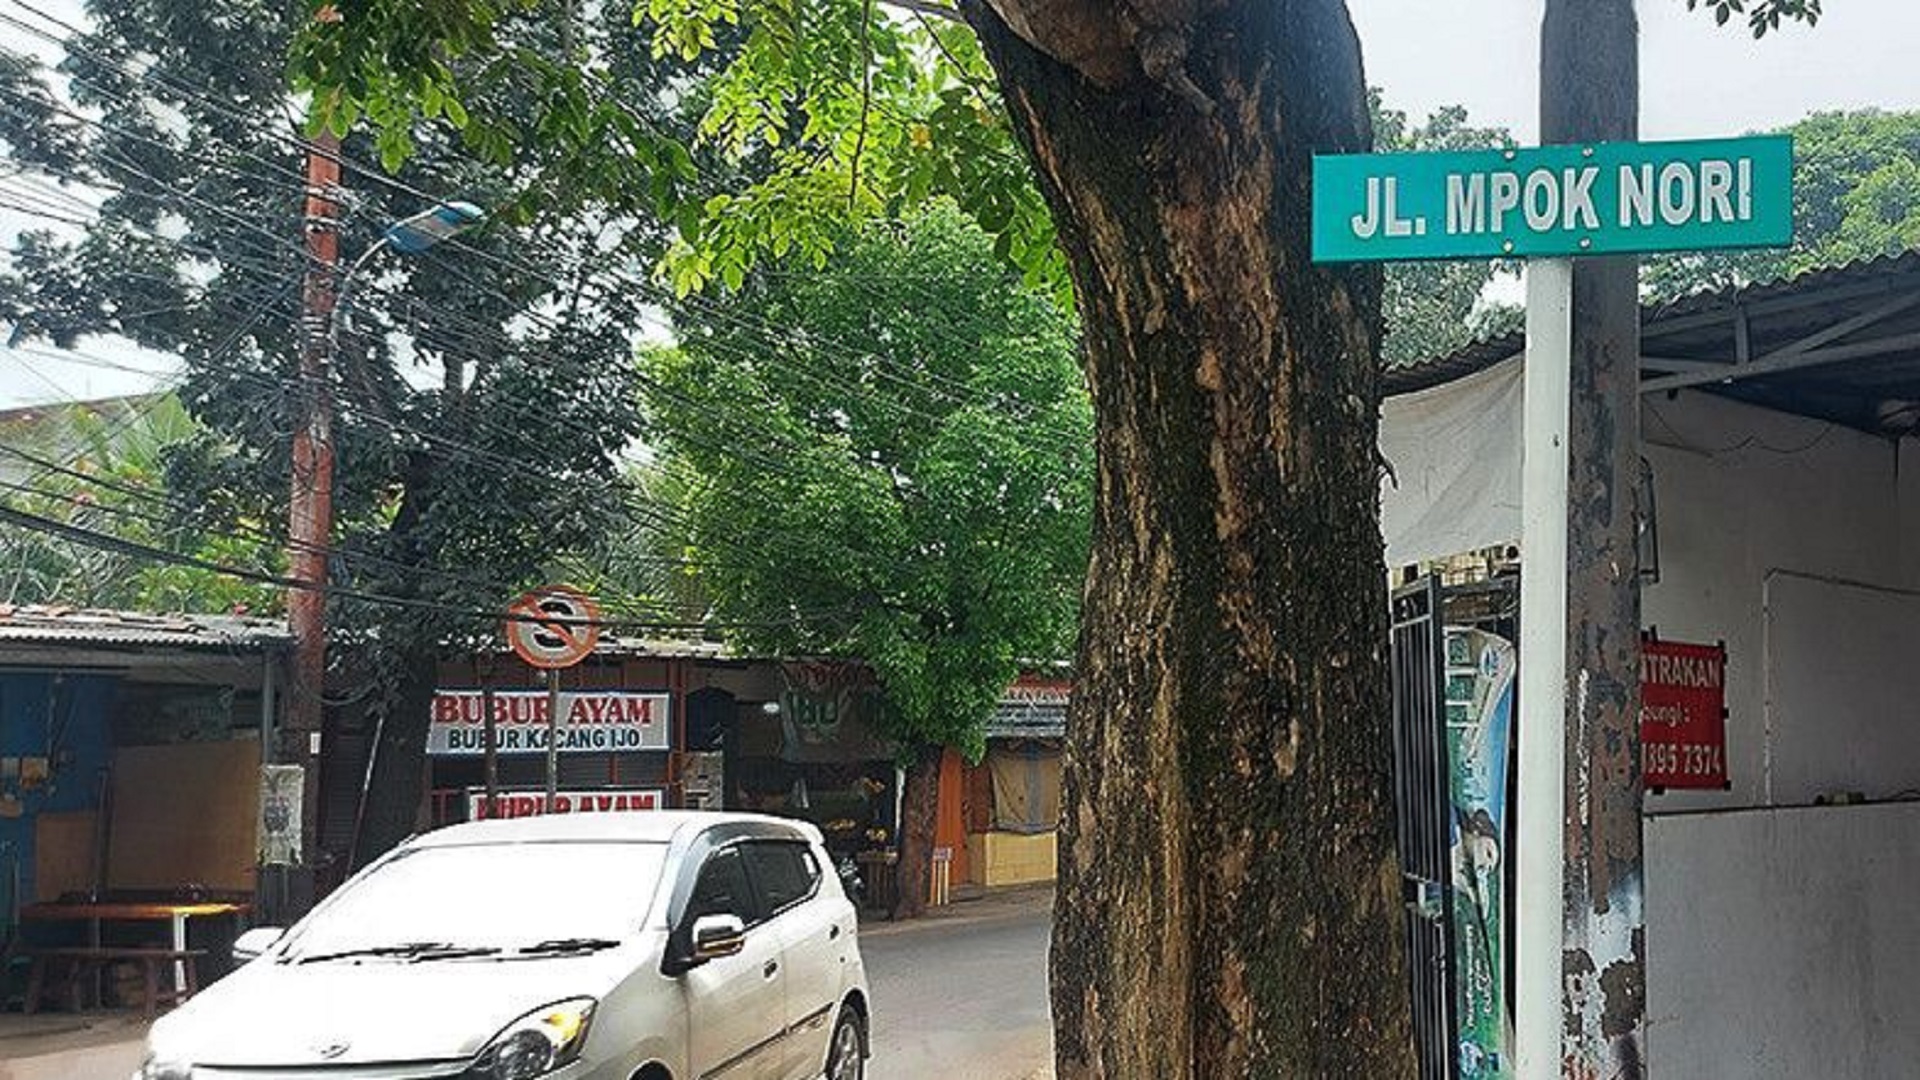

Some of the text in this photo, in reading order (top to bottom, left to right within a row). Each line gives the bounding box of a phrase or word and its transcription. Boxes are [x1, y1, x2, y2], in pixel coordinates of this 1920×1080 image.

[1352, 158, 1752, 239] JL. MPOK NORI
[568, 697, 652, 724] AYAM
[610, 728, 641, 748] IJO
